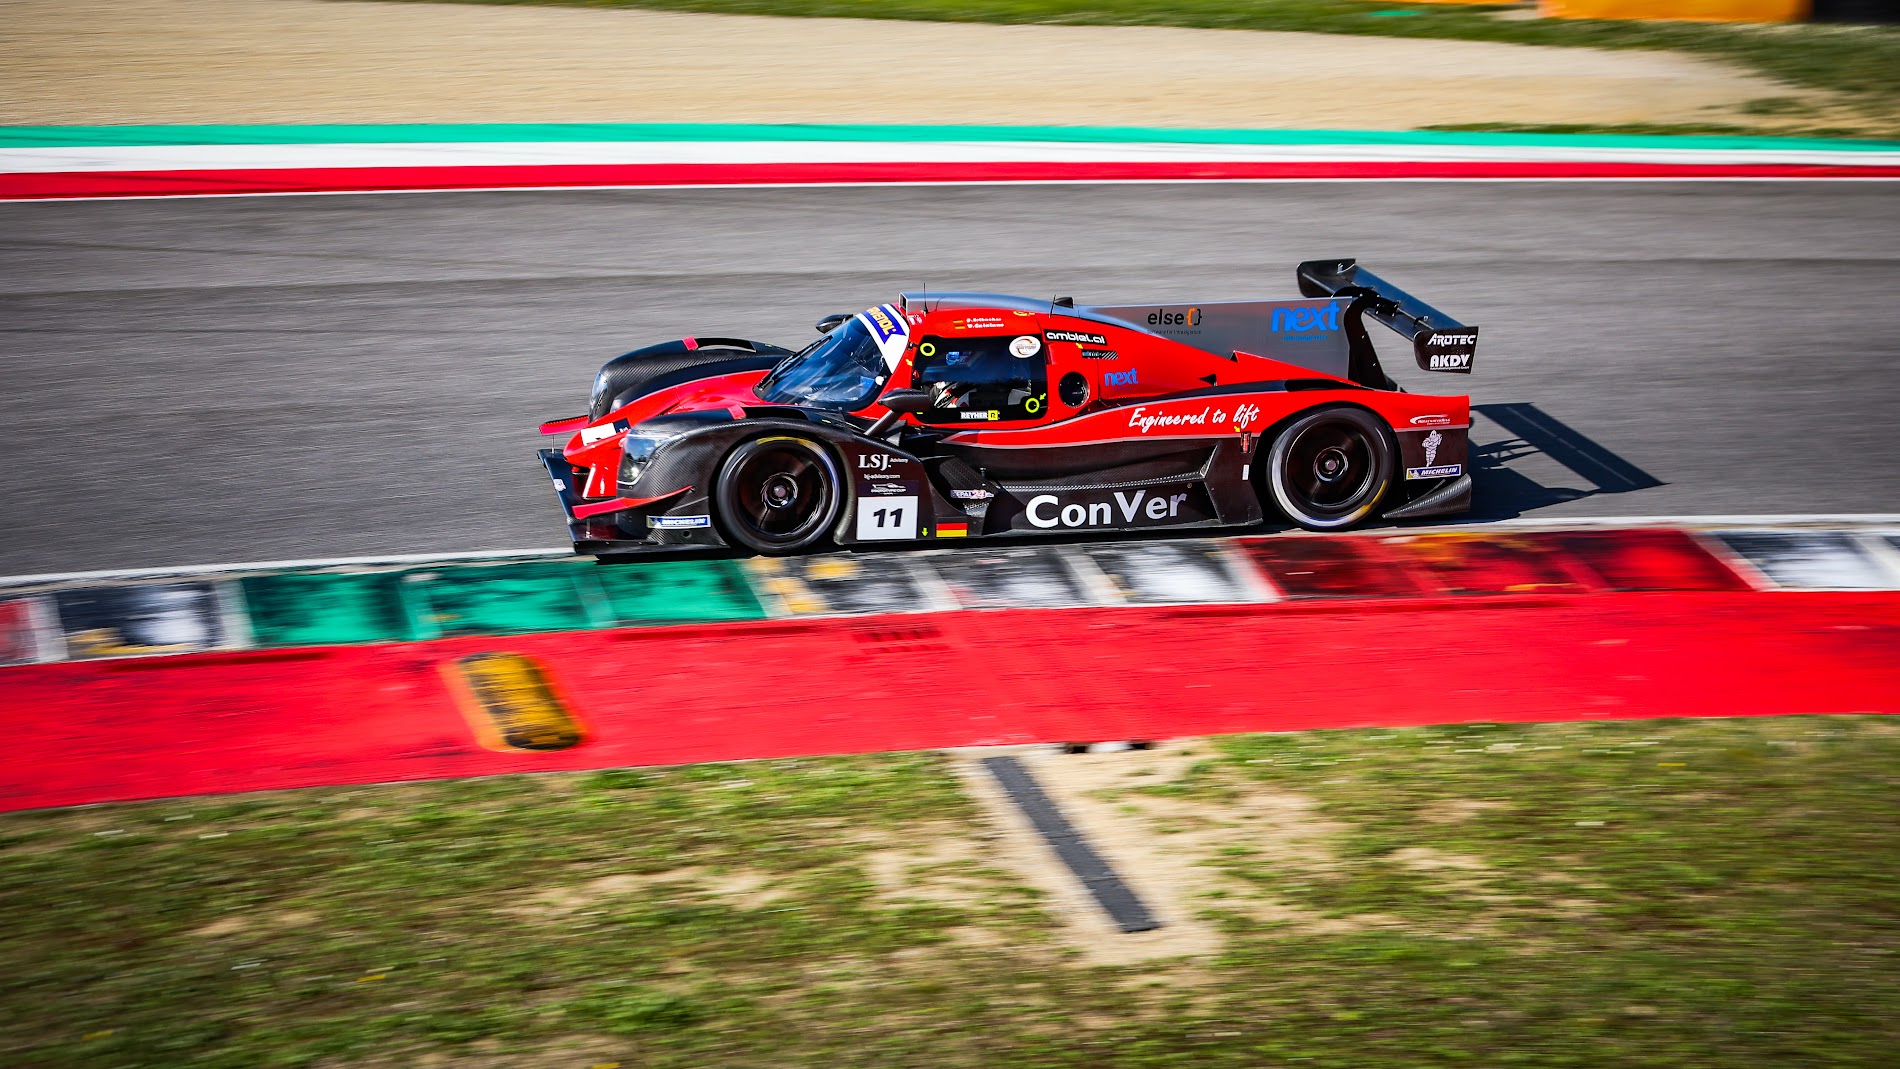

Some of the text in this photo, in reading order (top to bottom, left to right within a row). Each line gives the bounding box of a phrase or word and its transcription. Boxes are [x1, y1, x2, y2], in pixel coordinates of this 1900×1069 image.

[1271, 300, 1340, 332] next
[1427, 333, 1476, 347] AROTEC
[1430, 354, 1470, 367] AKDV
[1104, 367, 1138, 386] next
[1128, 404, 1260, 433] Engineered to lift
[1420, 467, 1457, 476] MICHELIN
[873, 508, 903, 528] 11
[1025, 490, 1187, 528] ConVer
